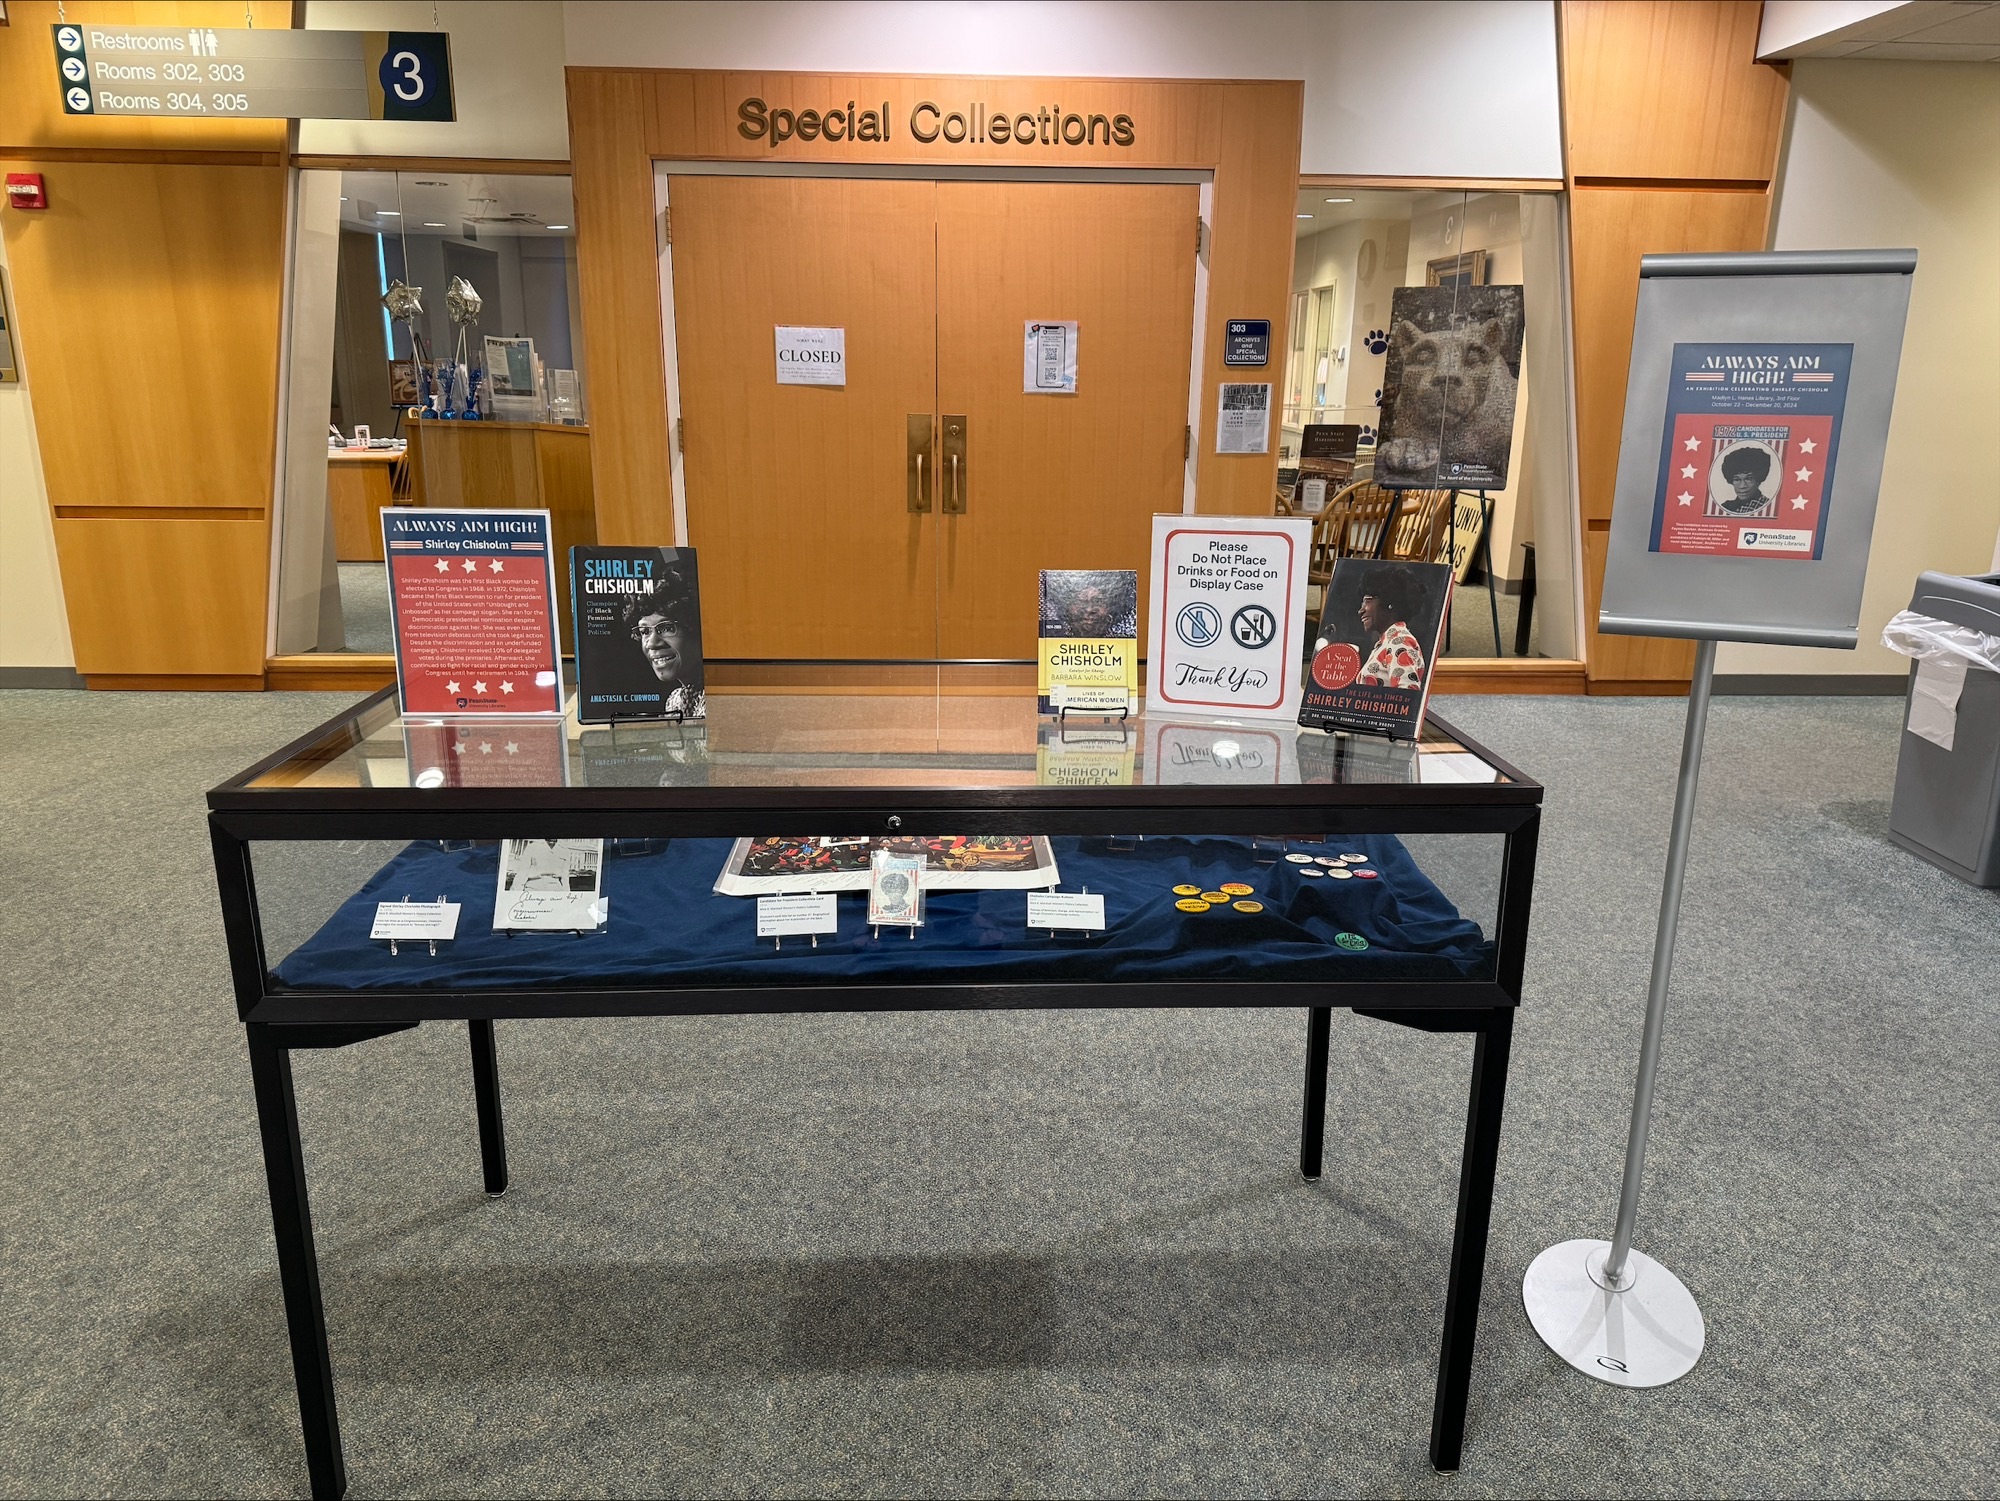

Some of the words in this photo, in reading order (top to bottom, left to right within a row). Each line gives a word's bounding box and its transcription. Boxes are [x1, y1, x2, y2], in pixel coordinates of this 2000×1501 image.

[91, 31, 185, 50] Restrooms
[95, 62, 156, 80] Rooms
[163, 63, 202, 84] 302,
[208, 64, 245, 82] 303
[391, 50, 425, 101] 3
[99, 91, 160, 110] Rooms
[166, 93, 206, 112] 304,
[212, 94, 248, 111] 305
[737, 96, 890, 147] Special
[910, 100, 1136, 146] Collections
[1231, 324, 1246, 333] 303
[779, 349, 842, 363] CLOSED
[1701, 356, 1779, 369] ALWAYS
[1783, 356, 1820, 369] AIM
[1732, 371, 1785, 384] HIGH!
[1714, 425, 1737, 437] 1972
[393, 520, 456, 532] ALWAYS
[461, 521, 490, 533] AIM
[494, 521, 538, 533] HIGH!
[425, 539, 461, 551] Shirley
[462, 540, 509, 550] Chisholm
[1209, 541, 1249, 552] Please
[1192, 553, 1208, 564] Do
[1210, 554, 1232, 565] Not
[1234, 554, 1267, 566] Place
[584, 559, 653, 578] SHIRLEY
[1177, 565, 1213, 577] Drinks
[1216, 568, 1228, 577] or
[1230, 567, 1260, 578] Food
[1263, 570, 1278, 579] on
[585, 579, 654, 594] CHISHOLM
[1190, 578, 1232, 592] Display
[1234, 580, 1264, 591] Case
[1059, 644, 1114, 655] SHIRLEY
[1050, 655, 1122, 666] CHISHOLM
[1325, 653, 1331, 661] A
[1333, 652, 1352, 663] Seat
[1334, 662, 1347, 670] the
[1175, 662, 1228, 689] Thank
[1228, 666, 1268, 693] You
[1321, 670, 1348, 681] Table
[590, 694, 623, 703] ANASTASIA
[623, 694, 630, 703] C.
[630, 693, 660, 702] CURWOOD
[1358, 690, 1371, 699] LIFE
[1384, 694, 1403, 702] TIMES
[1307, 693, 1353, 709] SHIRLEY
[1354, 699, 1410, 716] CHISHOLM
